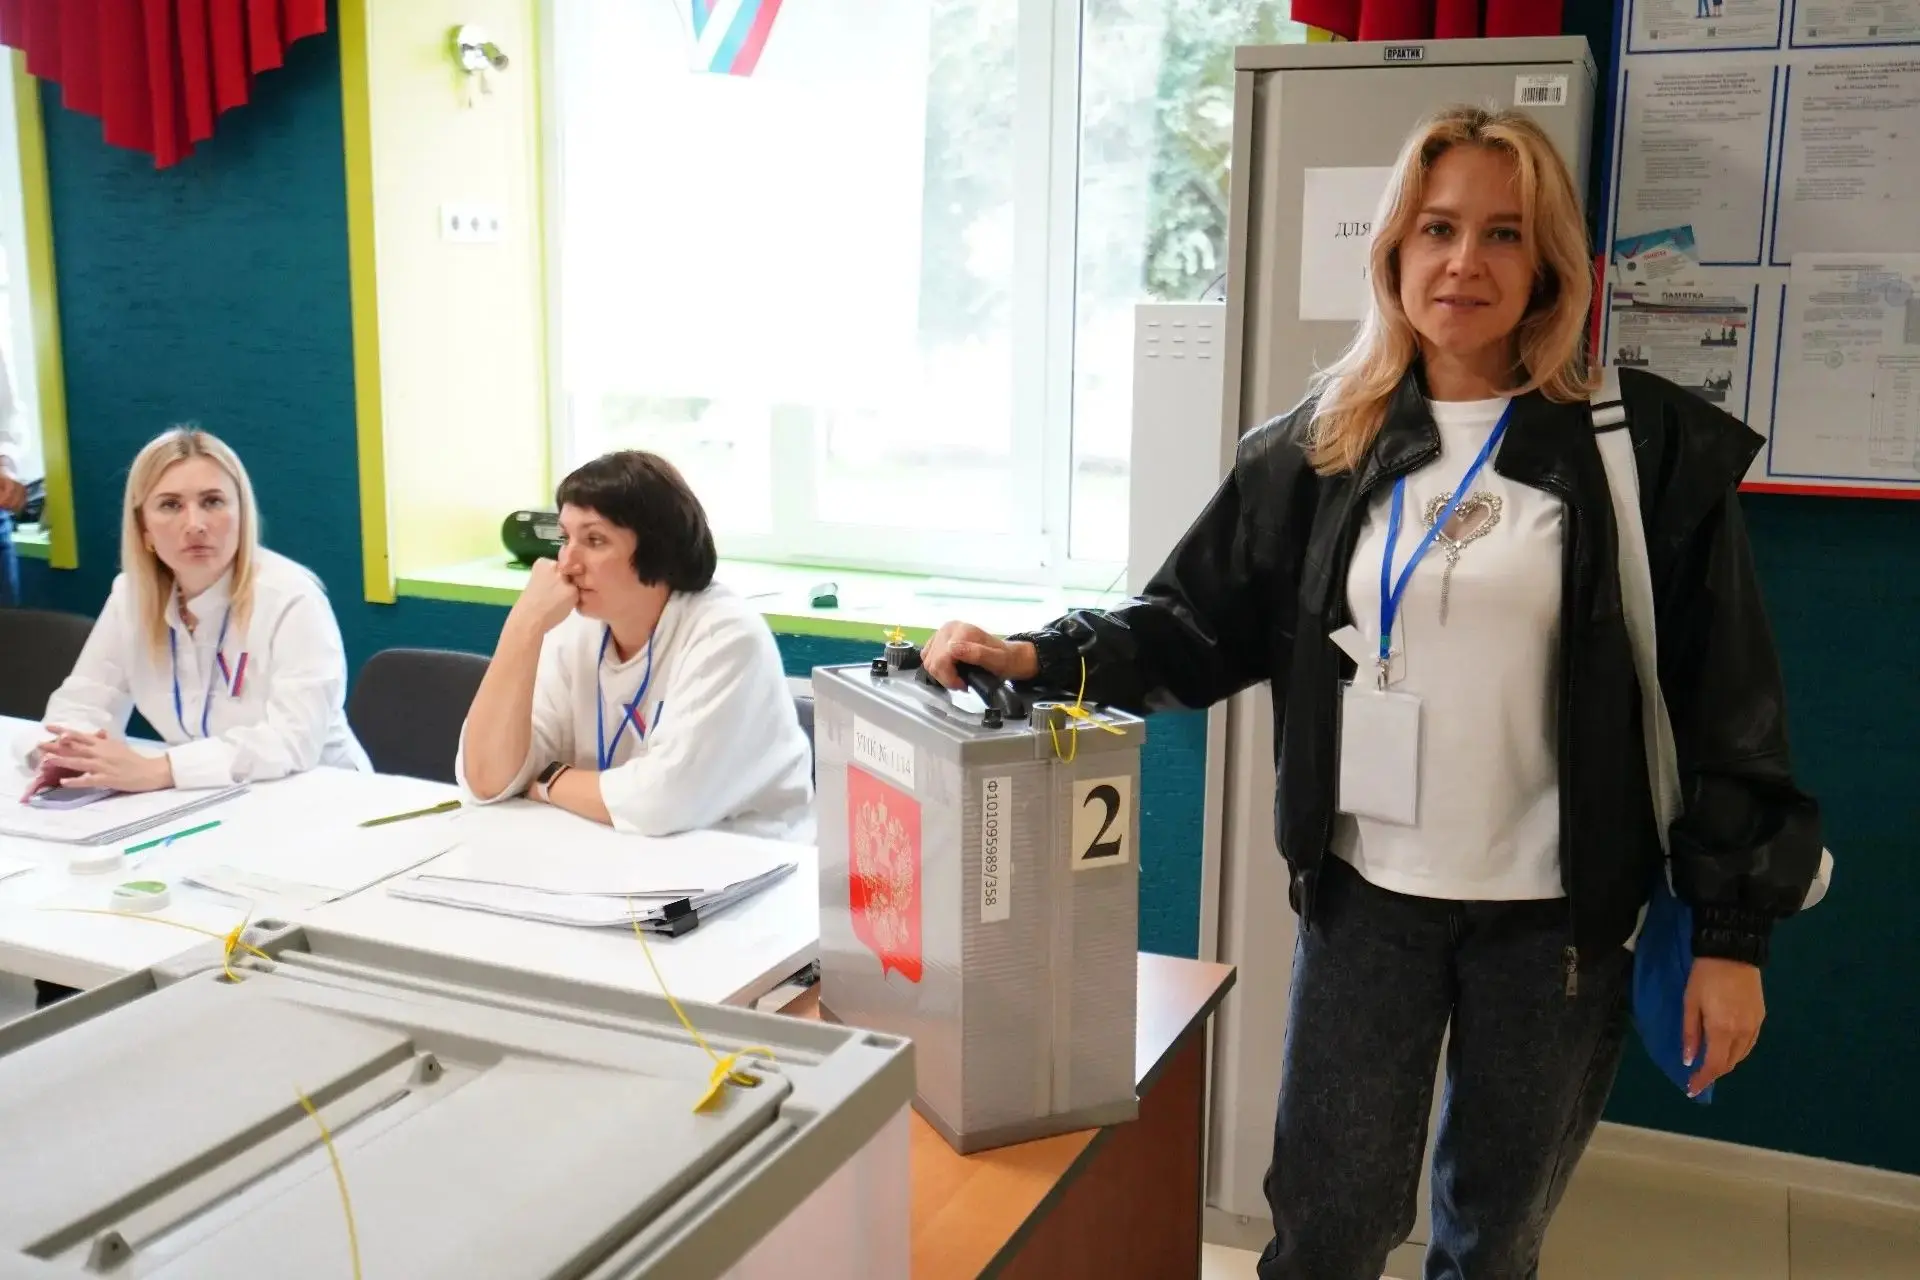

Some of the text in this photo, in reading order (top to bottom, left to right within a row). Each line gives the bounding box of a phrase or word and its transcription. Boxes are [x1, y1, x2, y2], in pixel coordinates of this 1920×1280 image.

[1334, 222, 1372, 239] ДЛЯ
[984, 780, 999, 906] Ф101095989/358
[1081, 784, 1122, 860] 2
